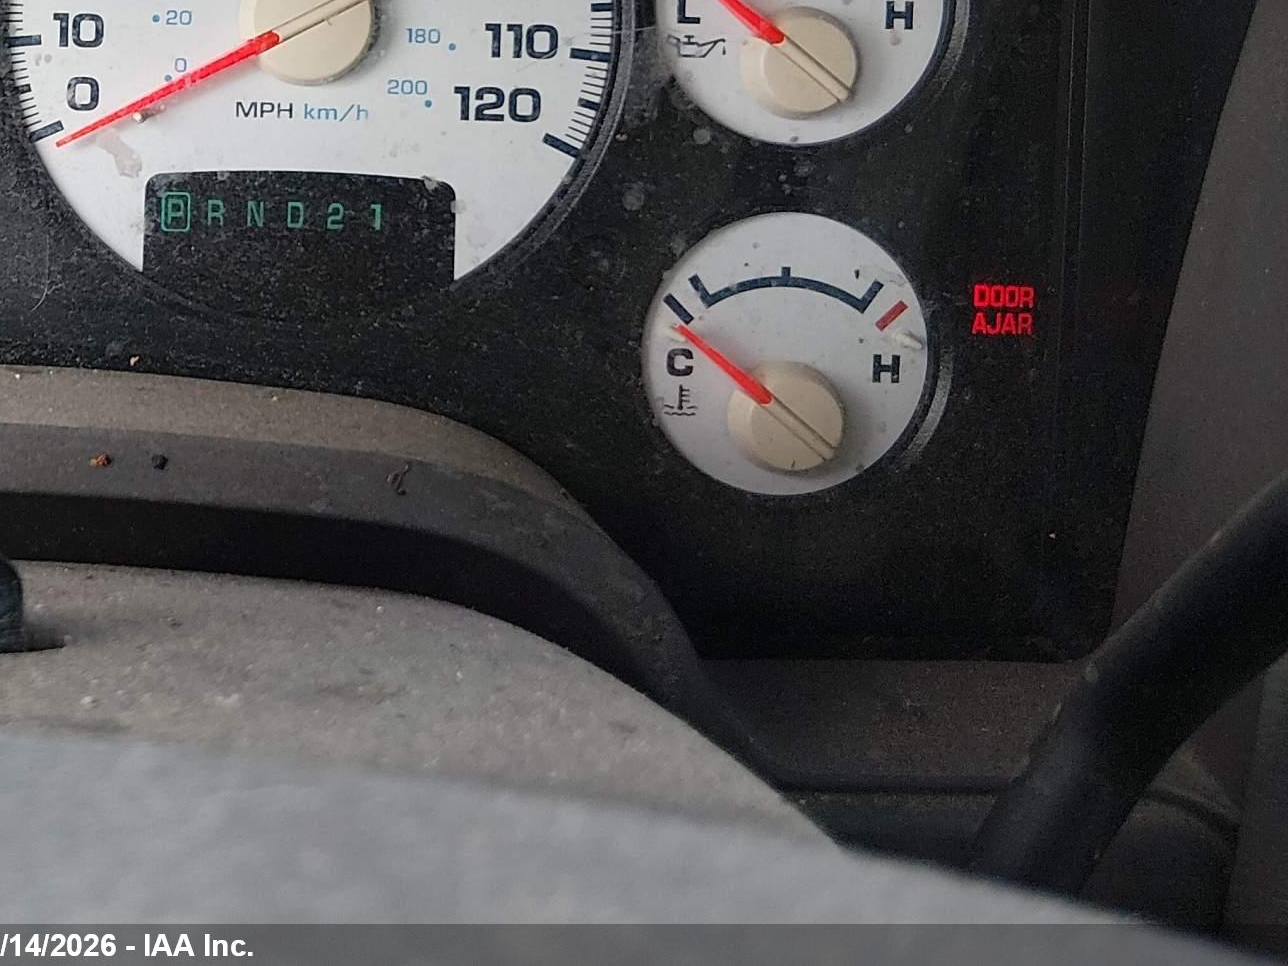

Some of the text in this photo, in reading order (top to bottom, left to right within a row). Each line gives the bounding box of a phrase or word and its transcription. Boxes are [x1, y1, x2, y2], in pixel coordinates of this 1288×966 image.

[165, 10, 192, 25] 20
[884, 1, 914, 30] H
[53, 13, 104, 48] 10
[406, 28, 441, 44] 180
[485, 23, 559, 60] 110
[174, 58, 187, 72] 0
[66, 76, 99, 111] 0
[387, 80, 428, 95] 200
[235, 101, 369, 122] MPH km/h
[454, 86, 541, 122] 120
[168, 200, 382, 230] P R N D 2 1
[974, 284, 1034, 307] DOOR
[972, 312, 1033, 335] AJAR
[667, 349, 694, 377] C
[872, 354, 901, 383] H
